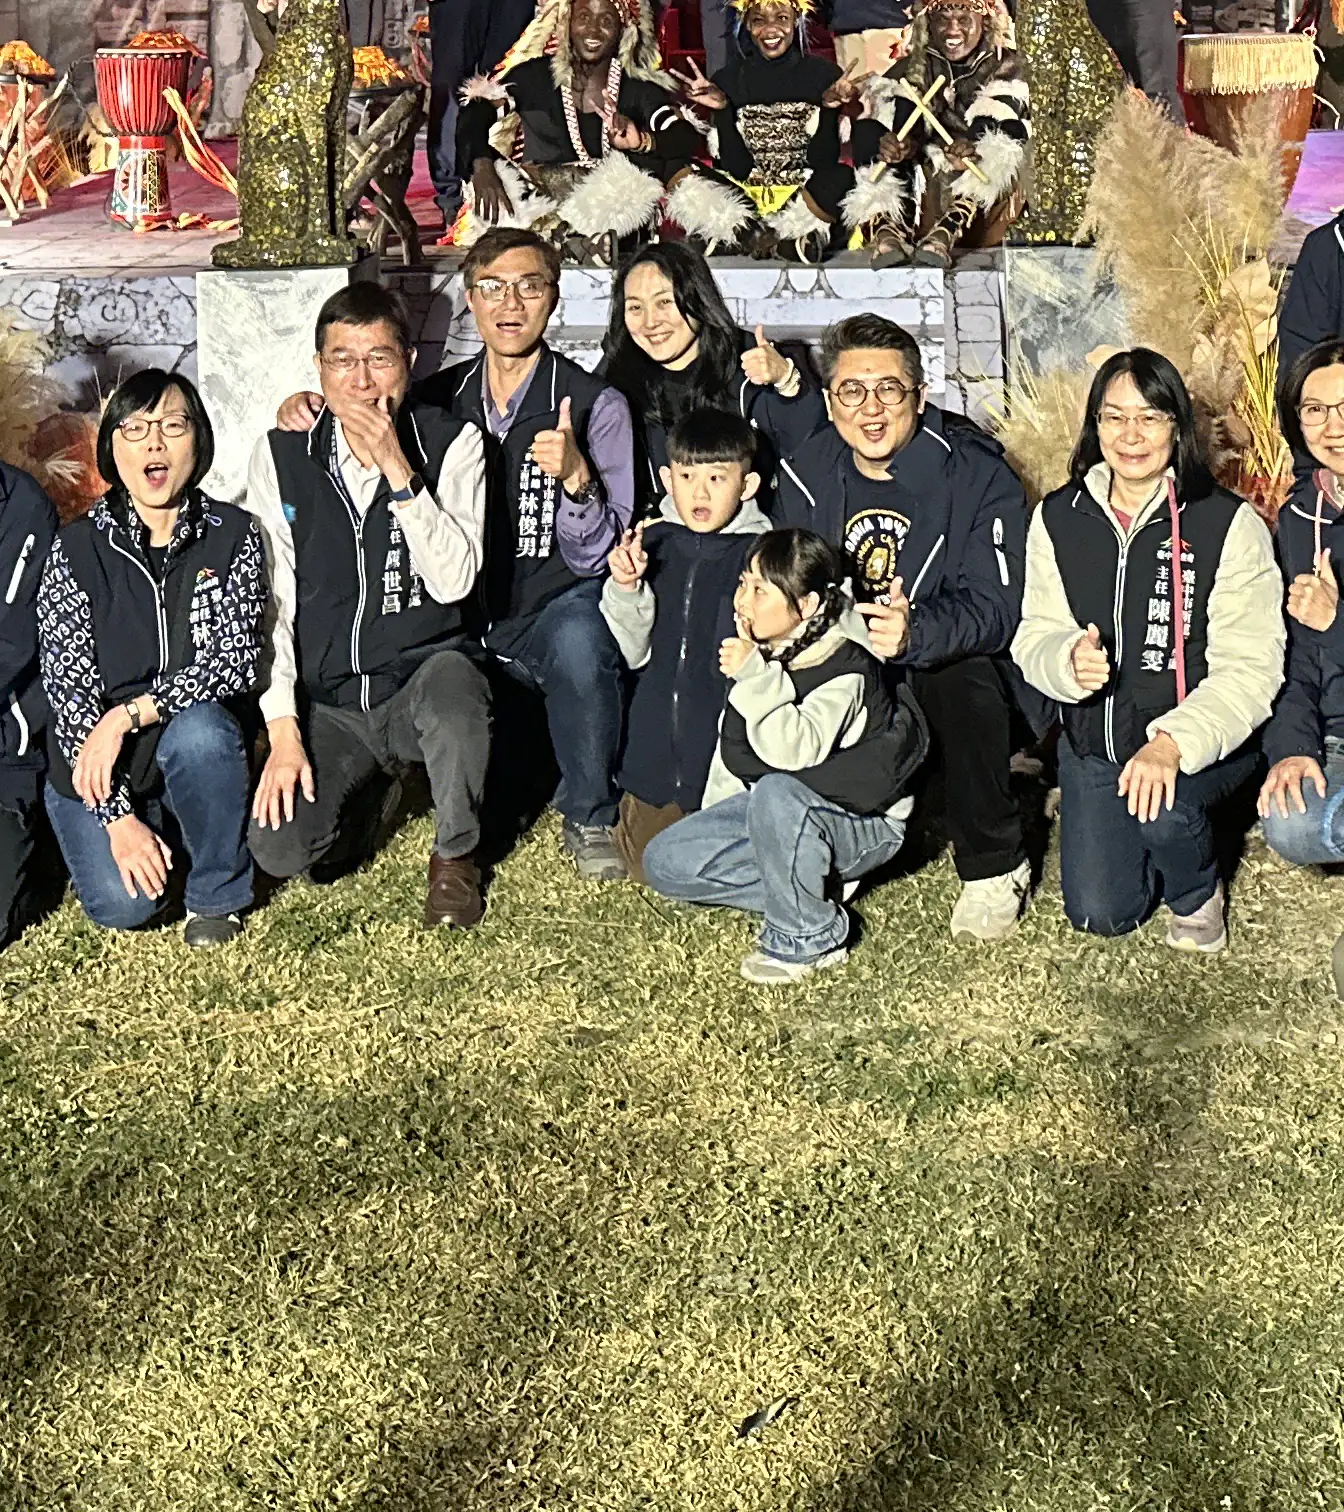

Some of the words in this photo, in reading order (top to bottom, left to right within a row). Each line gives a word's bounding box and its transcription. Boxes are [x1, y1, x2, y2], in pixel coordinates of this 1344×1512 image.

[516, 492, 539, 558] 林俊男
[1155, 565, 1170, 595] 主任
[1140, 597, 1172, 672] 陳麗雯
